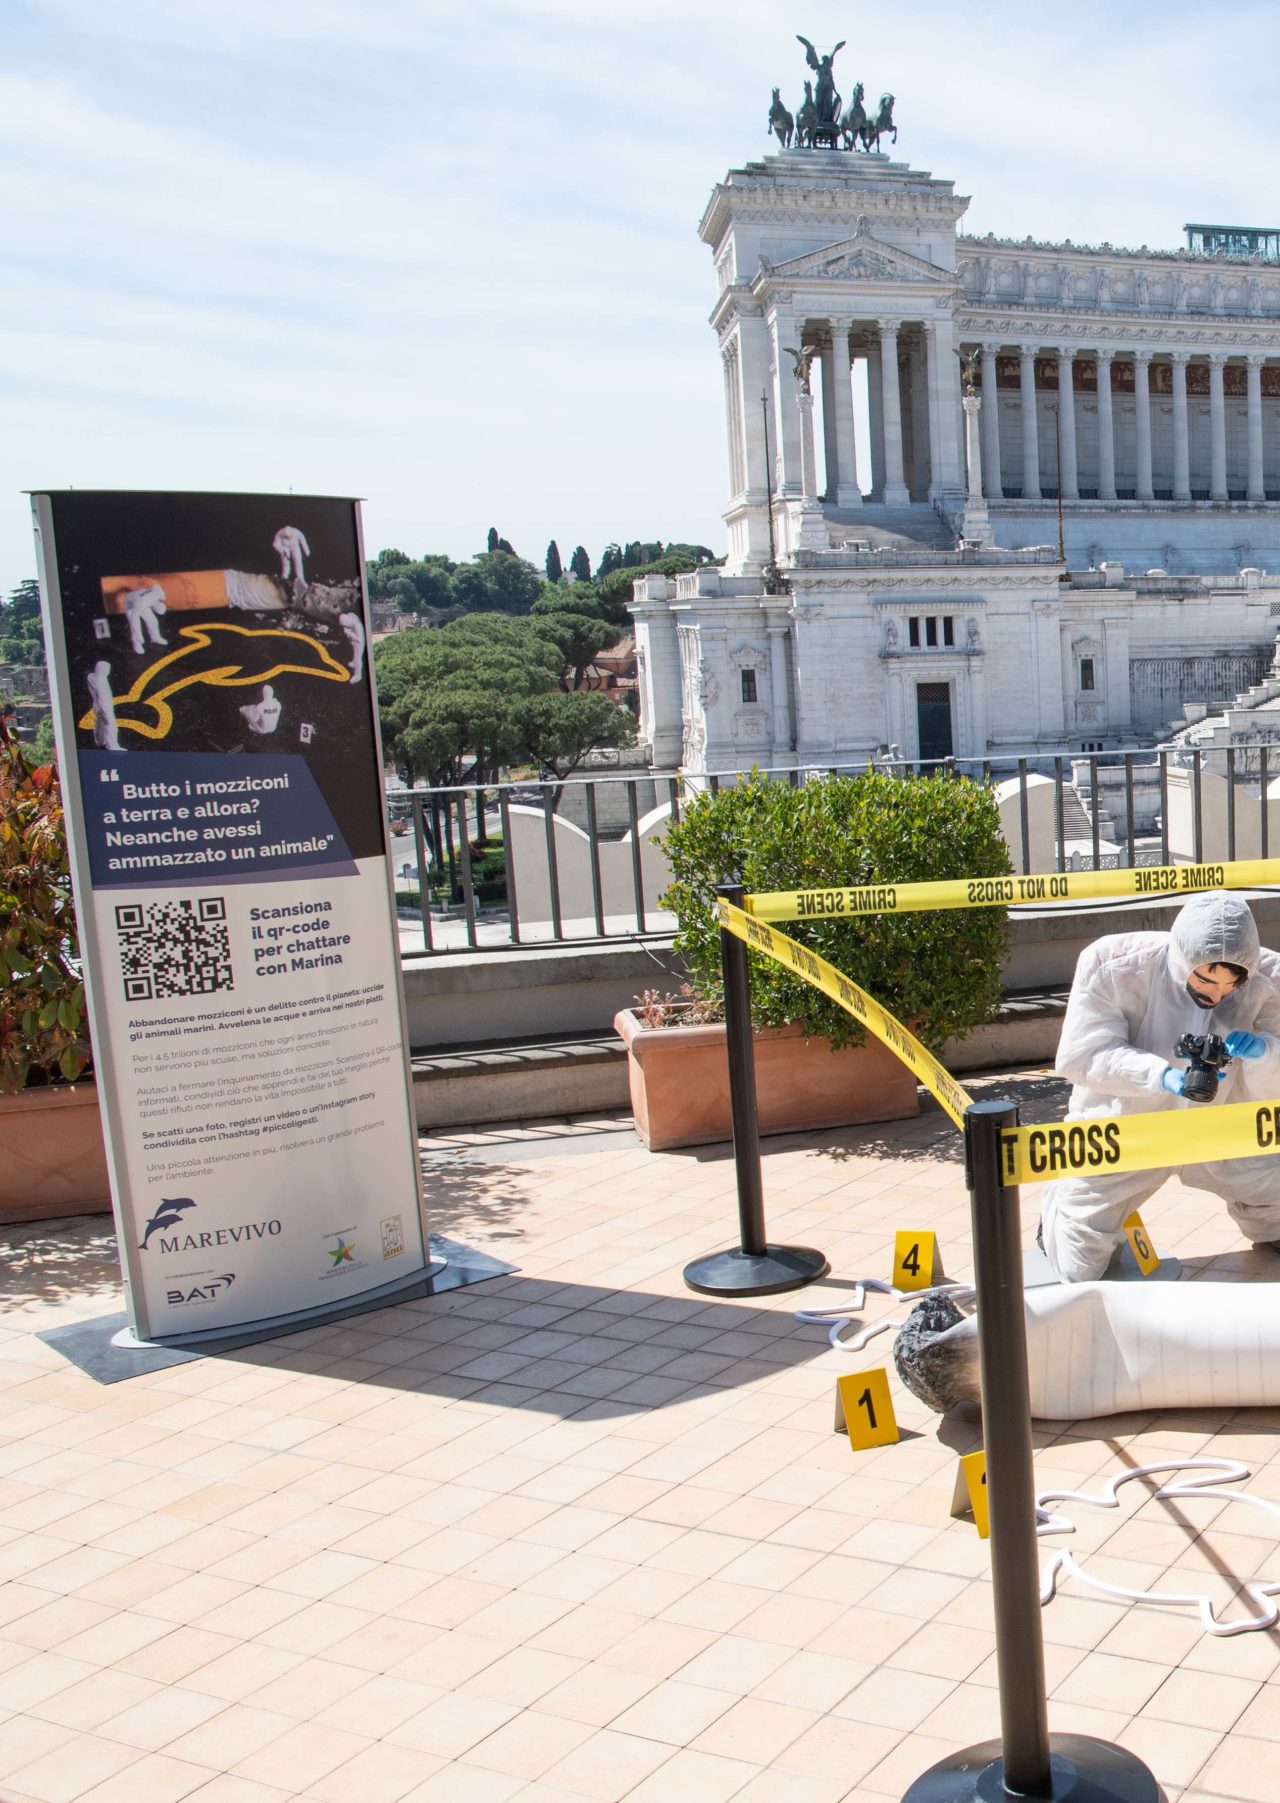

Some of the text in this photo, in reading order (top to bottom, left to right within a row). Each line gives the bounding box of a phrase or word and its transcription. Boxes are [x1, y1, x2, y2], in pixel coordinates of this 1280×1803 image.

[302, 726, 309, 738] 3
[185, 780, 191, 796] i
[196, 773, 289, 795] mozziconi
[103, 798, 260, 824] a terra e allora?
[105, 821, 262, 848] Neanche avessi
[108, 848, 227, 870] ammazzato
[231, 845, 255, 860] un
[249, 900, 333, 921] Scansiona
[251, 918, 330, 942] il qr-code
[254, 934, 351, 962] per chattare
[255, 953, 343, 977] con Marina
[128, 1015, 195, 1028] Abbandonare
[198, 1008, 244, 1021] mozziconi
[254, 1005, 267, 1014] un
[268, 1001, 297, 1012] delitto
[298, 996, 325, 1007] contro
[326, 994, 332, 1002] il
[362, 983, 384, 994] uccide
[130, 1031, 143, 1042] gli
[145, 1028, 181, 1039] animali
[183, 1024, 216, 1035] marini.
[218, 1017, 261, 1031] Avvelena
[263, 1015, 271, 1024] le
[273, 1011, 300, 1024] acque
[309, 1006, 331, 1017] arriva
[332, 1003, 344, 1012] nei
[345, 999, 365, 1009] nostri
[133, 1054, 148, 1063] Per
[171, 1048, 199, 1059] trilioni
[202, 1046, 211, 1055] di
[213, 1040, 257, 1054] mozziconi
[260, 1038, 275, 1049] che
[277, 1033, 295, 1046] ogni
[134, 1065, 152, 1075] non
[155, 1062, 192, 1073] servono
[137, 1085, 169, 1096] Aiutaci
[179, 1079, 216, 1091] fermare
[142, 1131, 155, 1140] Se
[157, 1126, 184, 1138] scatti
[186, 1125, 204, 1134] una
[229, 1115, 262, 1129] registri
[263, 1113, 275, 1122] un
[277, 1109, 301, 1121] video
[143, 1137, 197, 1150] condividila
[198, 1134, 216, 1143] con
[1029, 1122, 1121, 1174] CROSS
[146, 1162, 166, 1172] Una
[167, 1158, 202, 1171] piccola
[203, 1151, 251, 1165] attenzione
[147, 1174, 164, 1185] per
[159, 1219, 282, 1254] MAREVIVO
[1133, 1229, 1150, 1261] 6
[902, 1243, 921, 1277] 4
[167, 1284, 222, 1304] BAT
[858, 1387, 878, 1429] 1
